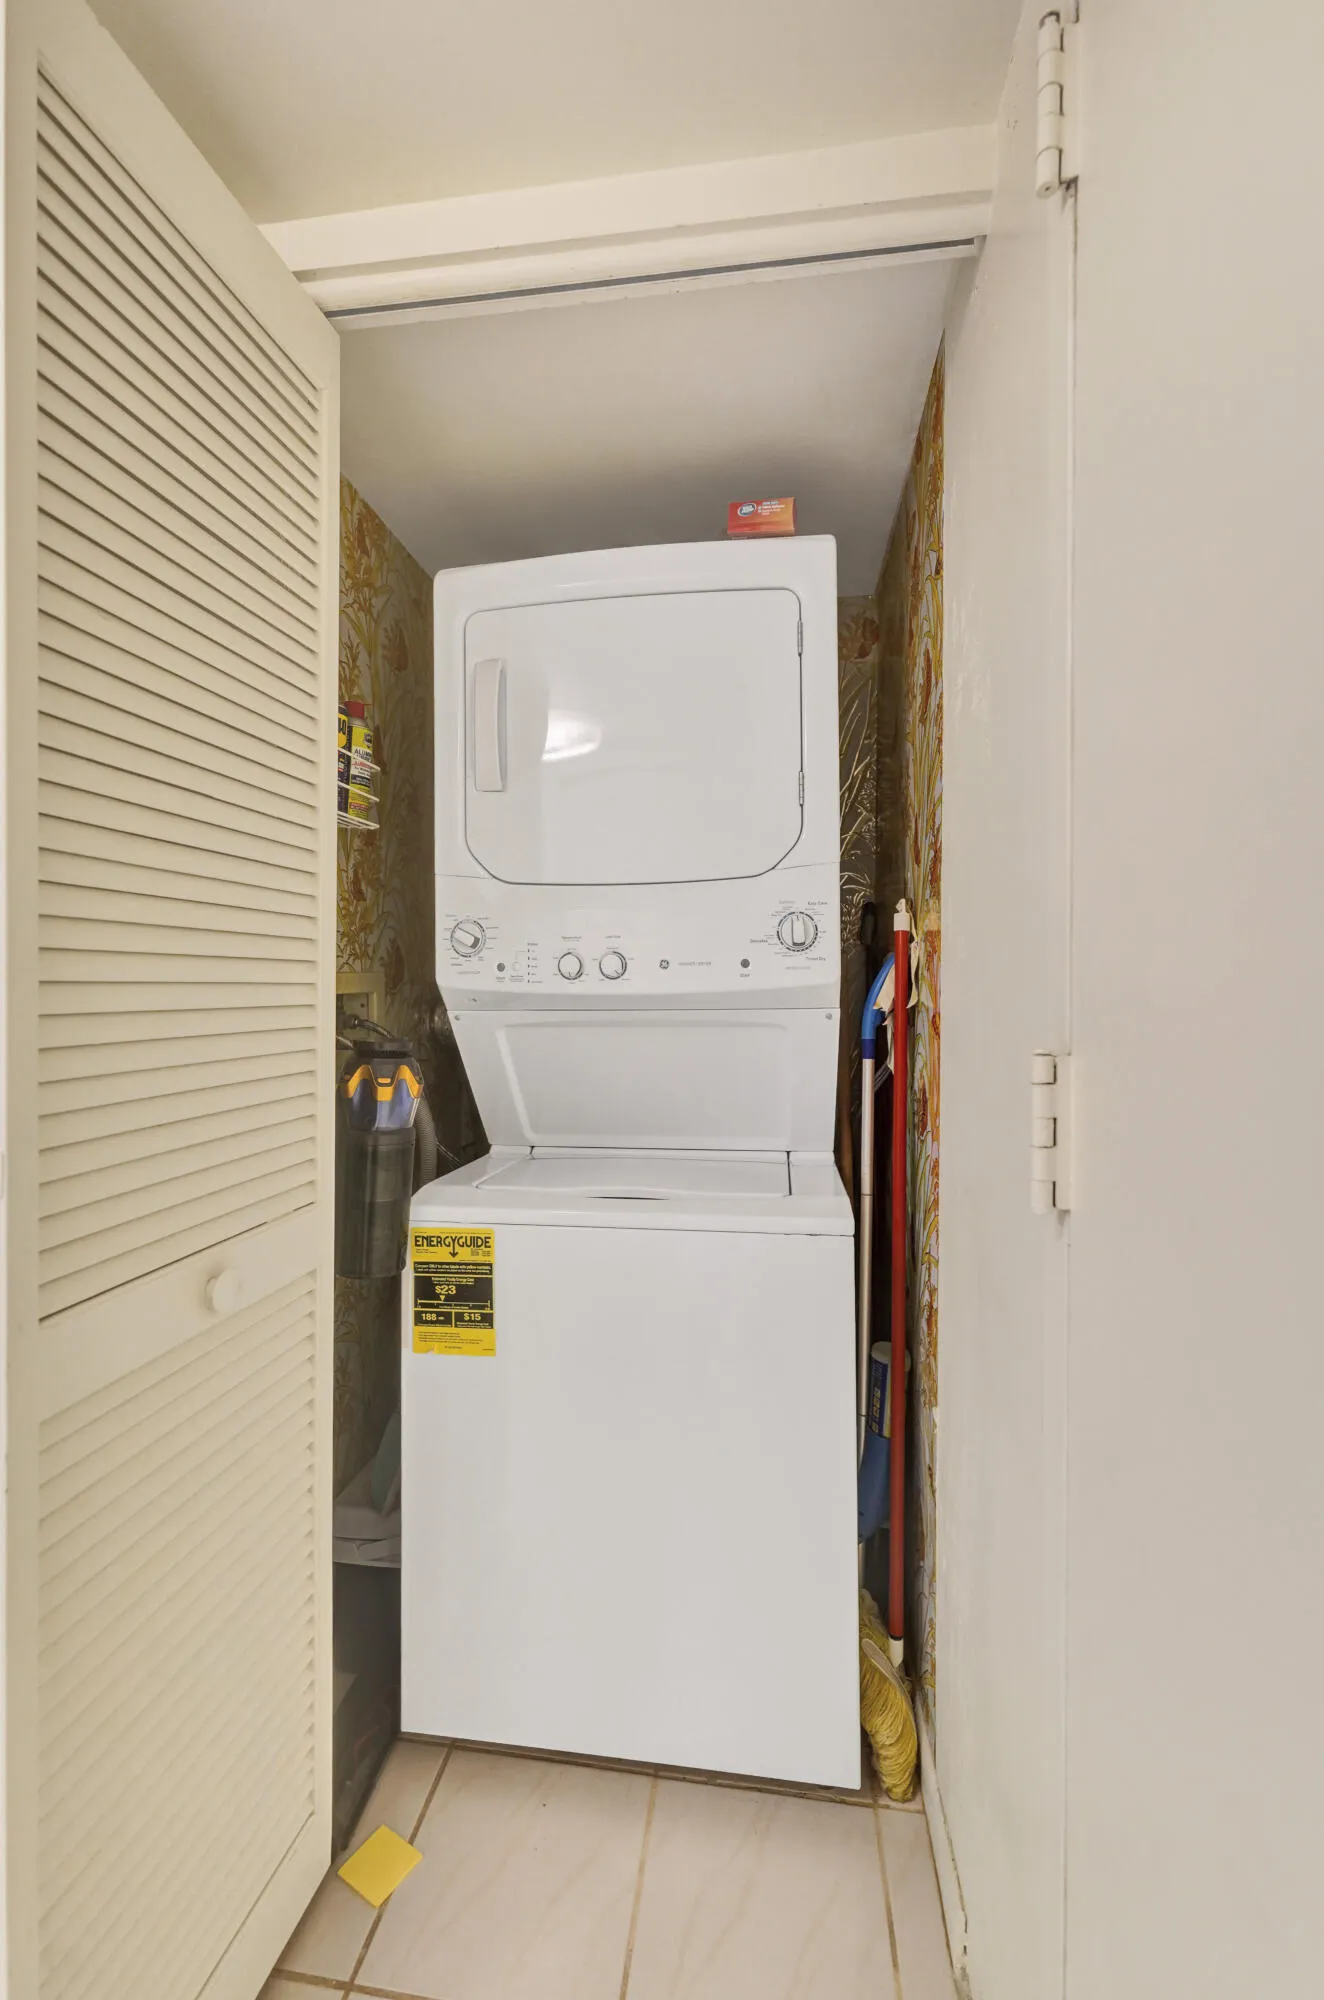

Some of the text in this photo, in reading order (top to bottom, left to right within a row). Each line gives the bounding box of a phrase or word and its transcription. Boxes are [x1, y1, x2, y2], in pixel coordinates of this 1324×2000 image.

[415, 1235, 491, 1248] ENERGYGUIDE
[435, 1285, 457, 1295] $23
[421, 1313, 437, 1321] 188
[463, 1313, 481, 1321] $15
